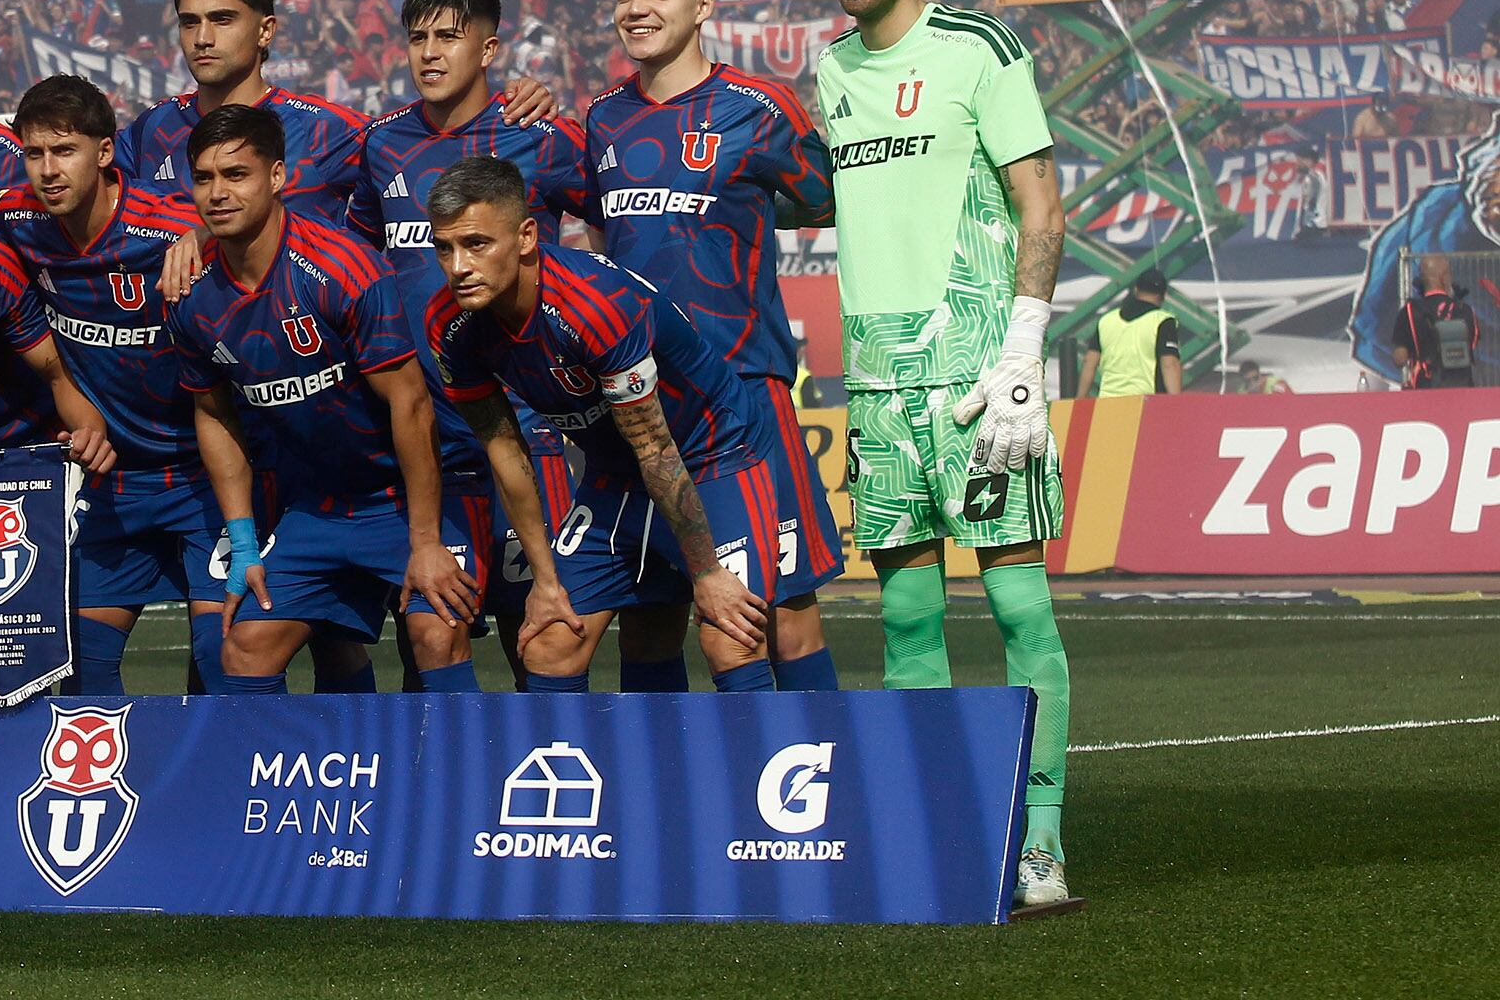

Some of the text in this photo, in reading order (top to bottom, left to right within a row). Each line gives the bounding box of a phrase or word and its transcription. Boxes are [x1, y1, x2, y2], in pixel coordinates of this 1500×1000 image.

[819, 41, 852, 62] CHBANK
[287, 98, 321, 114] HBANK
[726, 83, 781, 119] MACHBANK
[895, 80, 924, 118] U
[681, 131, 721, 172] U
[840, 136, 936, 169] JUGABET
[609, 189, 717, 216] JUGABET
[109, 272, 146, 311] U
[57, 314, 161, 347] JUGABET
[282, 313, 323, 357] U
[245, 362, 346, 406] JUGABET
[550, 365, 596, 396] U
[18, 481, 28, 491] DE
[29, 479, 52, 490] CHILE
[1202, 420, 1500, 537] zapp
[715, 536, 748, 557] GABET
[23, 627, 41, 635] LIBRE
[25, 613, 41, 623] 200
[250, 752, 380, 790] MACH
[47, 799, 107, 868] U
[243, 798, 373, 836] BANK
[307, 850, 326, 868] de
[473, 832, 612, 859] SODIMAC
[726, 840, 847, 862] GATORADE
